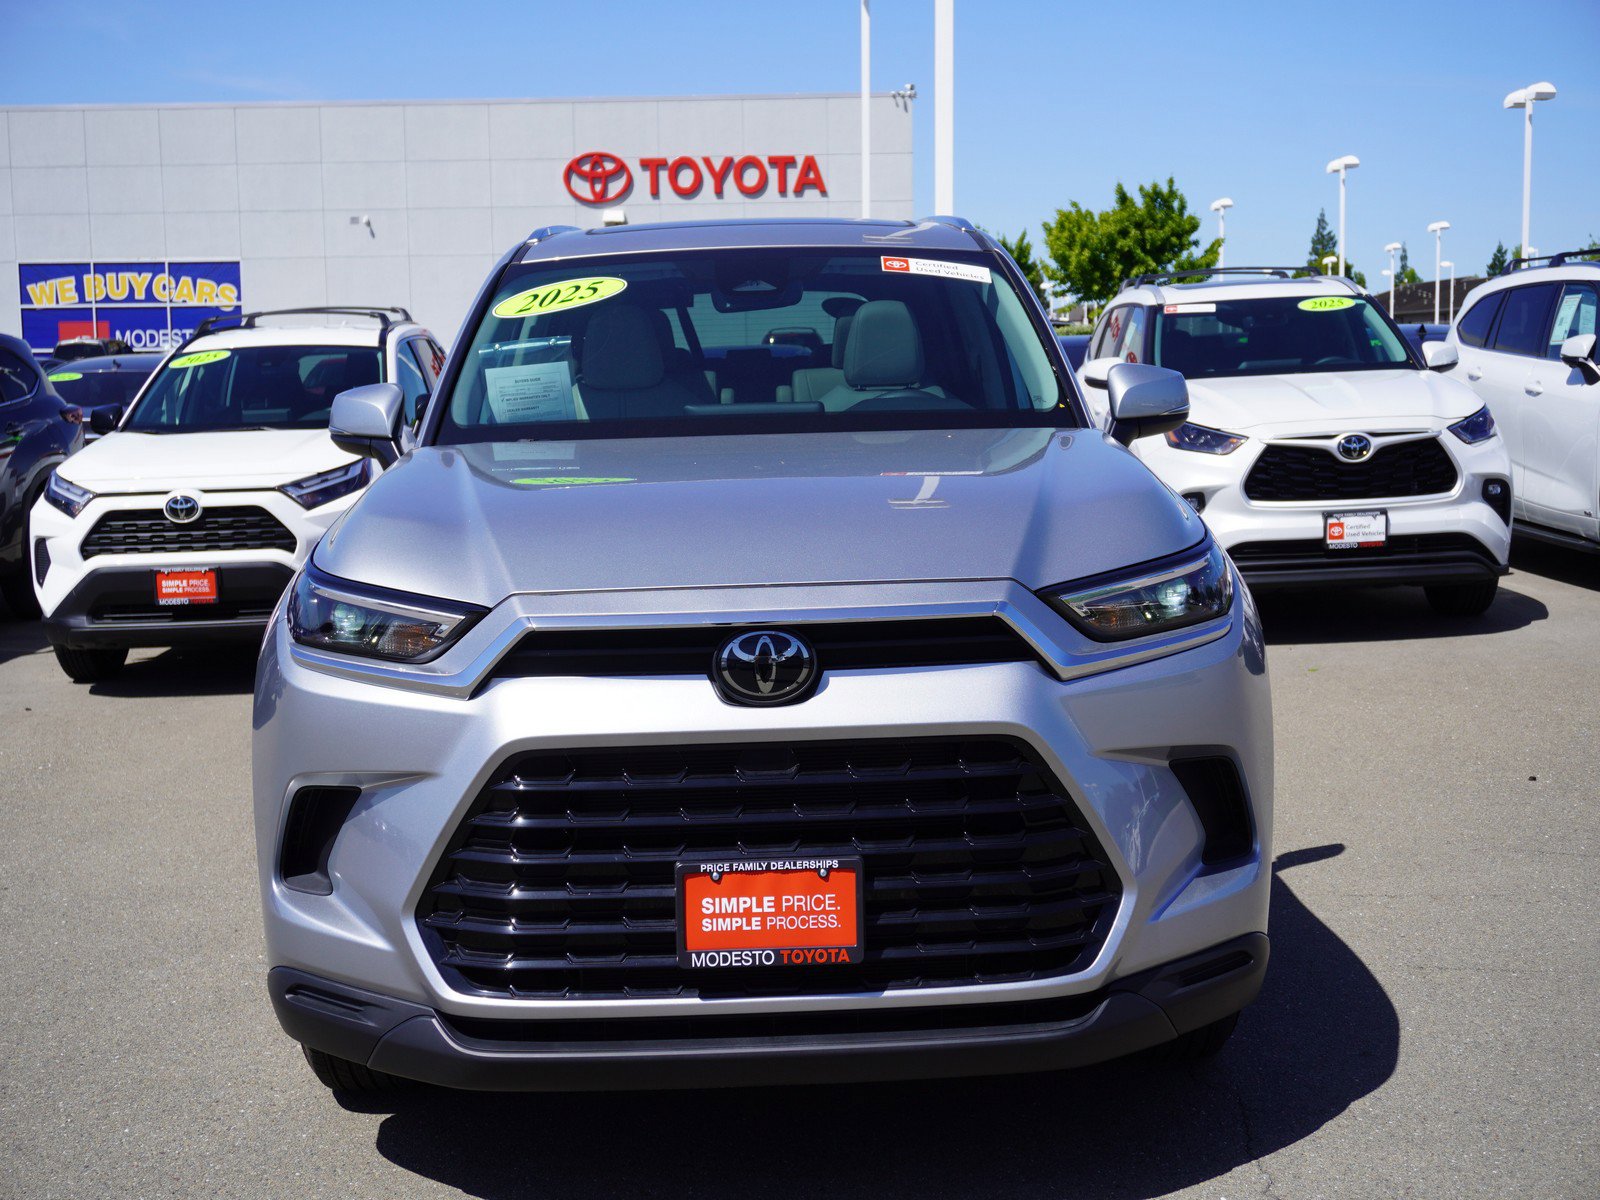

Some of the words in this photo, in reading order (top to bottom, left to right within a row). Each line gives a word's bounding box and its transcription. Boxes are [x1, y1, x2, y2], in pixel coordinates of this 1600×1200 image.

[639, 155, 827, 197] TOYOTA
[915, 261, 958, 270] Certified
[944, 269, 984, 280] Vehicles
[26, 276, 79, 308] WE
[83, 272, 153, 302] BUY
[152, 273, 238, 311] CARS
[513, 280, 605, 315] 2025
[1311, 299, 1344, 310] 2025
[115, 328, 195, 348] MODEST
[700, 863, 730, 873] PRICE
[732, 861, 768, 872] FAMILY
[770, 859, 839, 871] DEALERSHIPS
[701, 896, 776, 914] SIMPLE
[781, 893, 841, 912] PRICE.
[701, 916, 762, 932] SIMPLE
[766, 914, 842, 930] PROCESS.
[691, 949, 775, 968] MODESTO
[779, 948, 850, 965] TOYOTA
